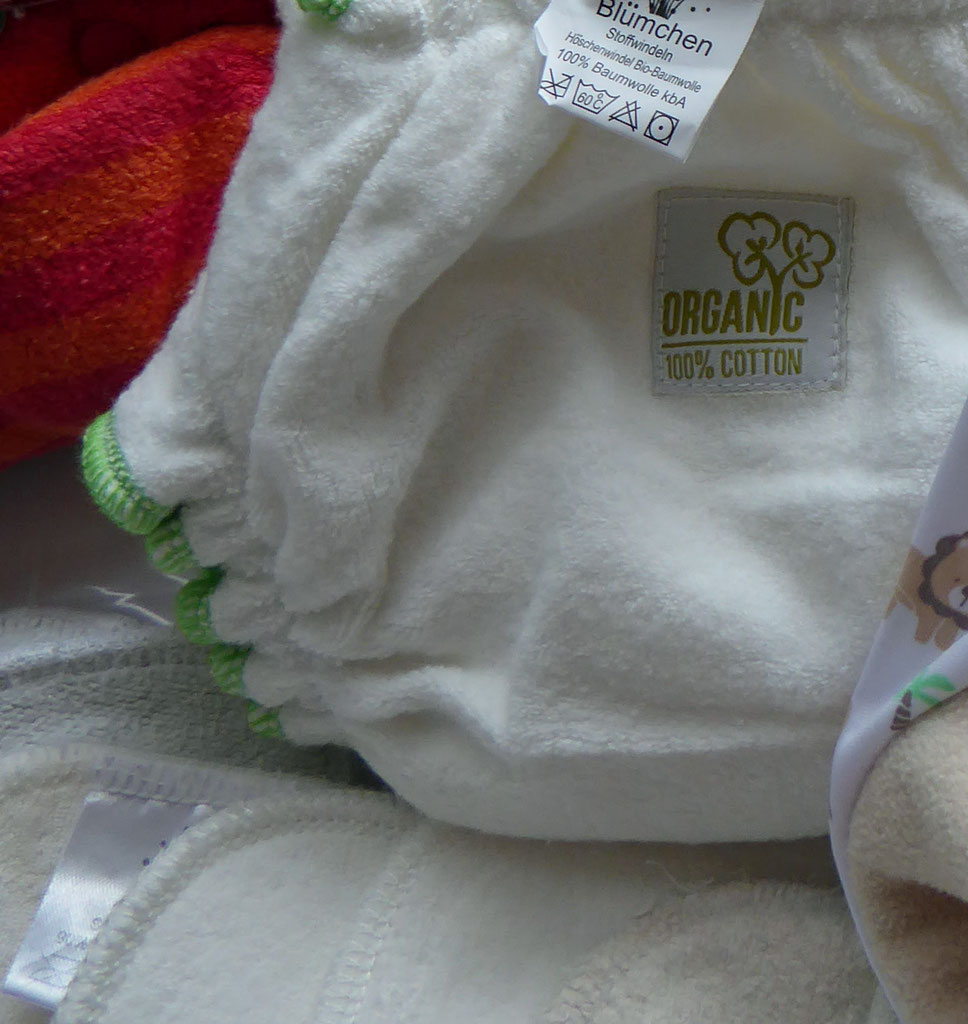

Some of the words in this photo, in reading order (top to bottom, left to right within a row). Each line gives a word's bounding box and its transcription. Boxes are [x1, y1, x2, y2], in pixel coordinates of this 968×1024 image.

[565, 31, 635, 67] Höschenwindel
[633, 60, 703, 93] Bio-Baumwolle
[605, 27, 674, 63] Stoffwindeln
[556, 48, 592, 69] 100%
[591, 61, 661, 99] Baumwolle
[661, 91, 688, 109] kbA
[661, 288, 805, 337] ORGANIC
[665, 349, 715, 380] 100%
[720, 347, 804, 378] COTTON
